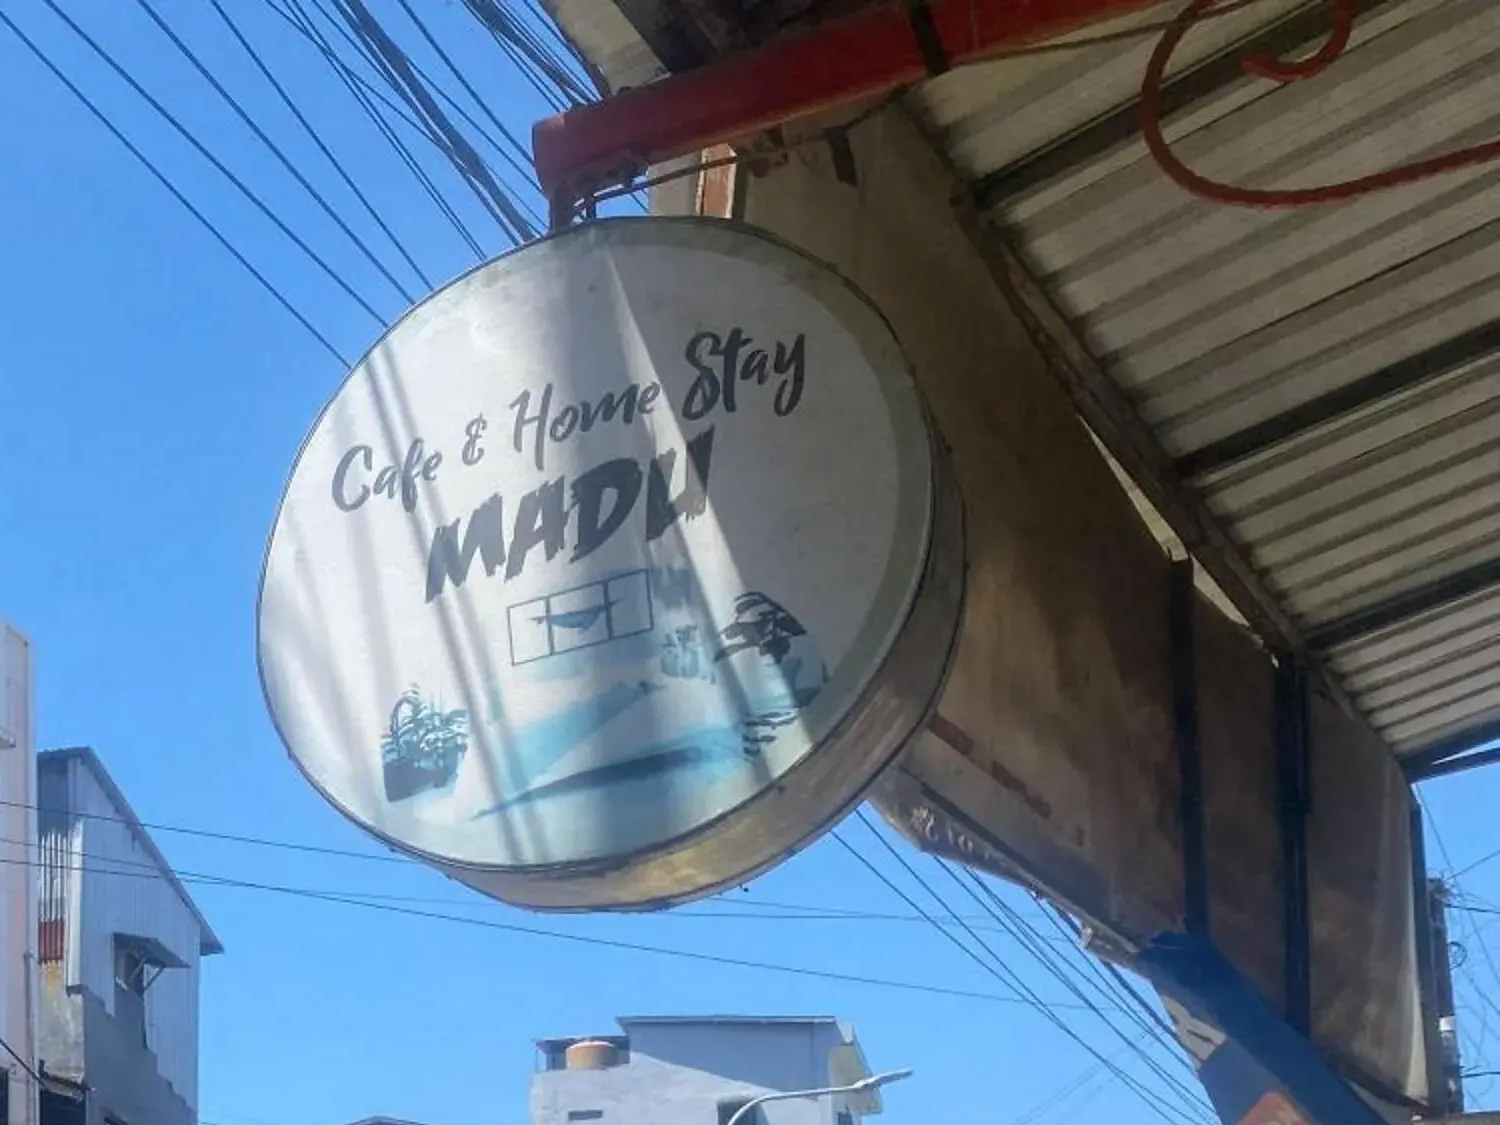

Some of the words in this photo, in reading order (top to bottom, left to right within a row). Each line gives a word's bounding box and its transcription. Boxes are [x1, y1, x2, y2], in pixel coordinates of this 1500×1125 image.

[331, 439, 440, 513] Cafe
[461, 413, 488, 466] &
[509, 380, 661, 471] Home
[681, 325, 807, 422] Stay
[425, 424, 714, 604] MADU
